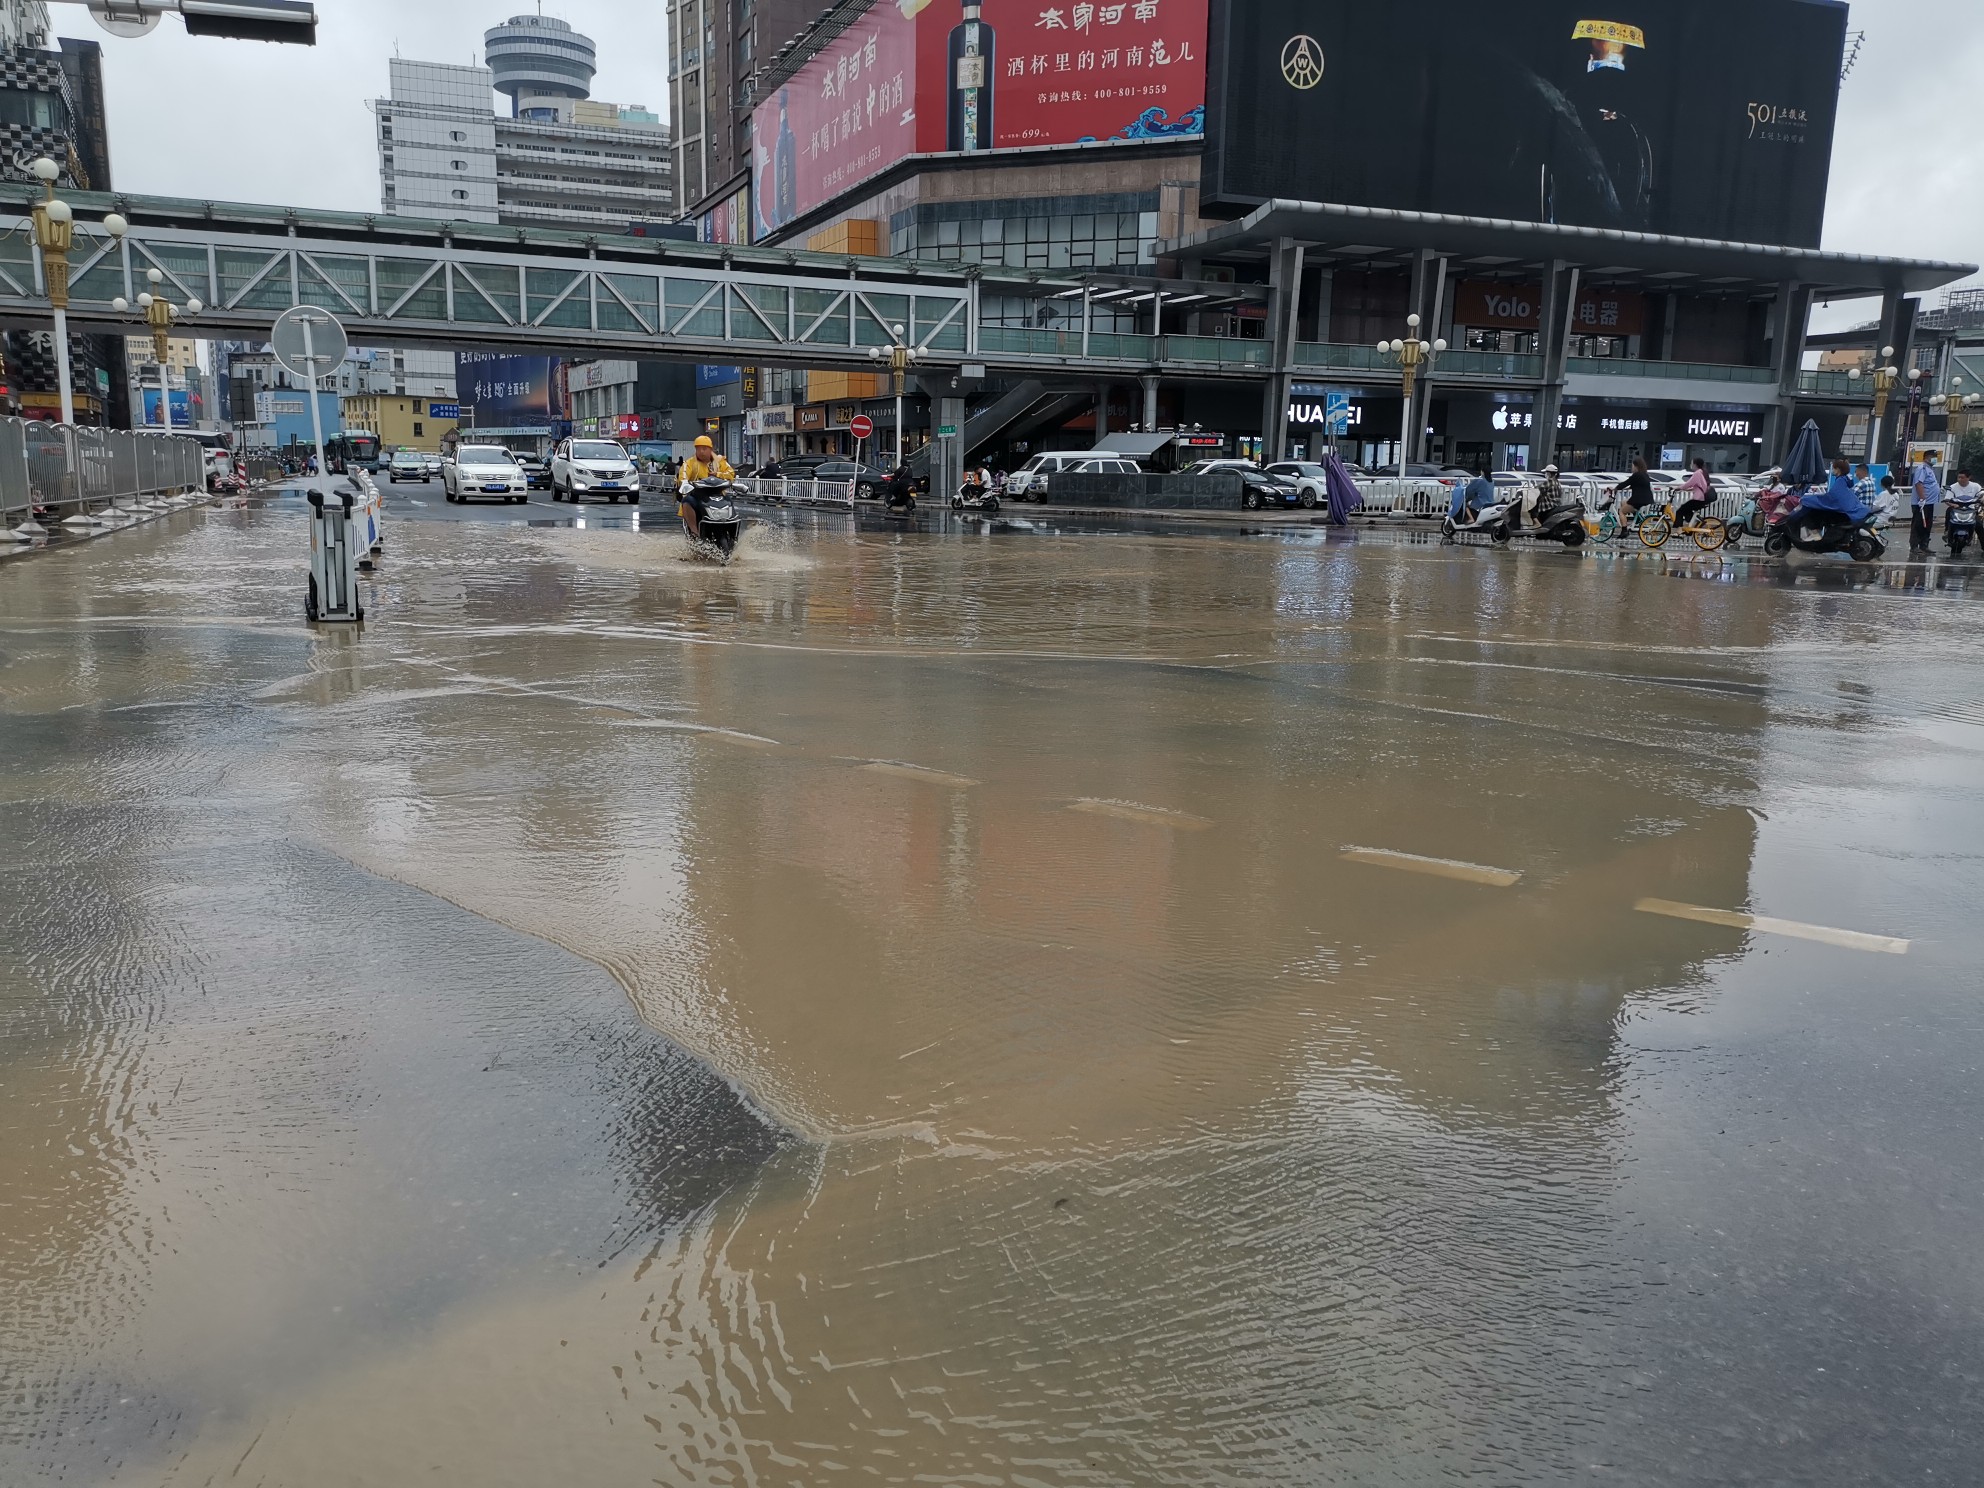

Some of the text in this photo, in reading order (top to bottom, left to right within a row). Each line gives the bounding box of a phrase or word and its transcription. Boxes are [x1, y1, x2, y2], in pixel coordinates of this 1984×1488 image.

[1007, 38, 1195, 77] 酒杯里的河南范儿
[1022, 129, 1040, 140] 699
[1484, 294, 1531, 318] Yolo
[1600, 418, 1649, 431] 手机售后维修
[1687, 419, 1749, 436] HUAWEI
